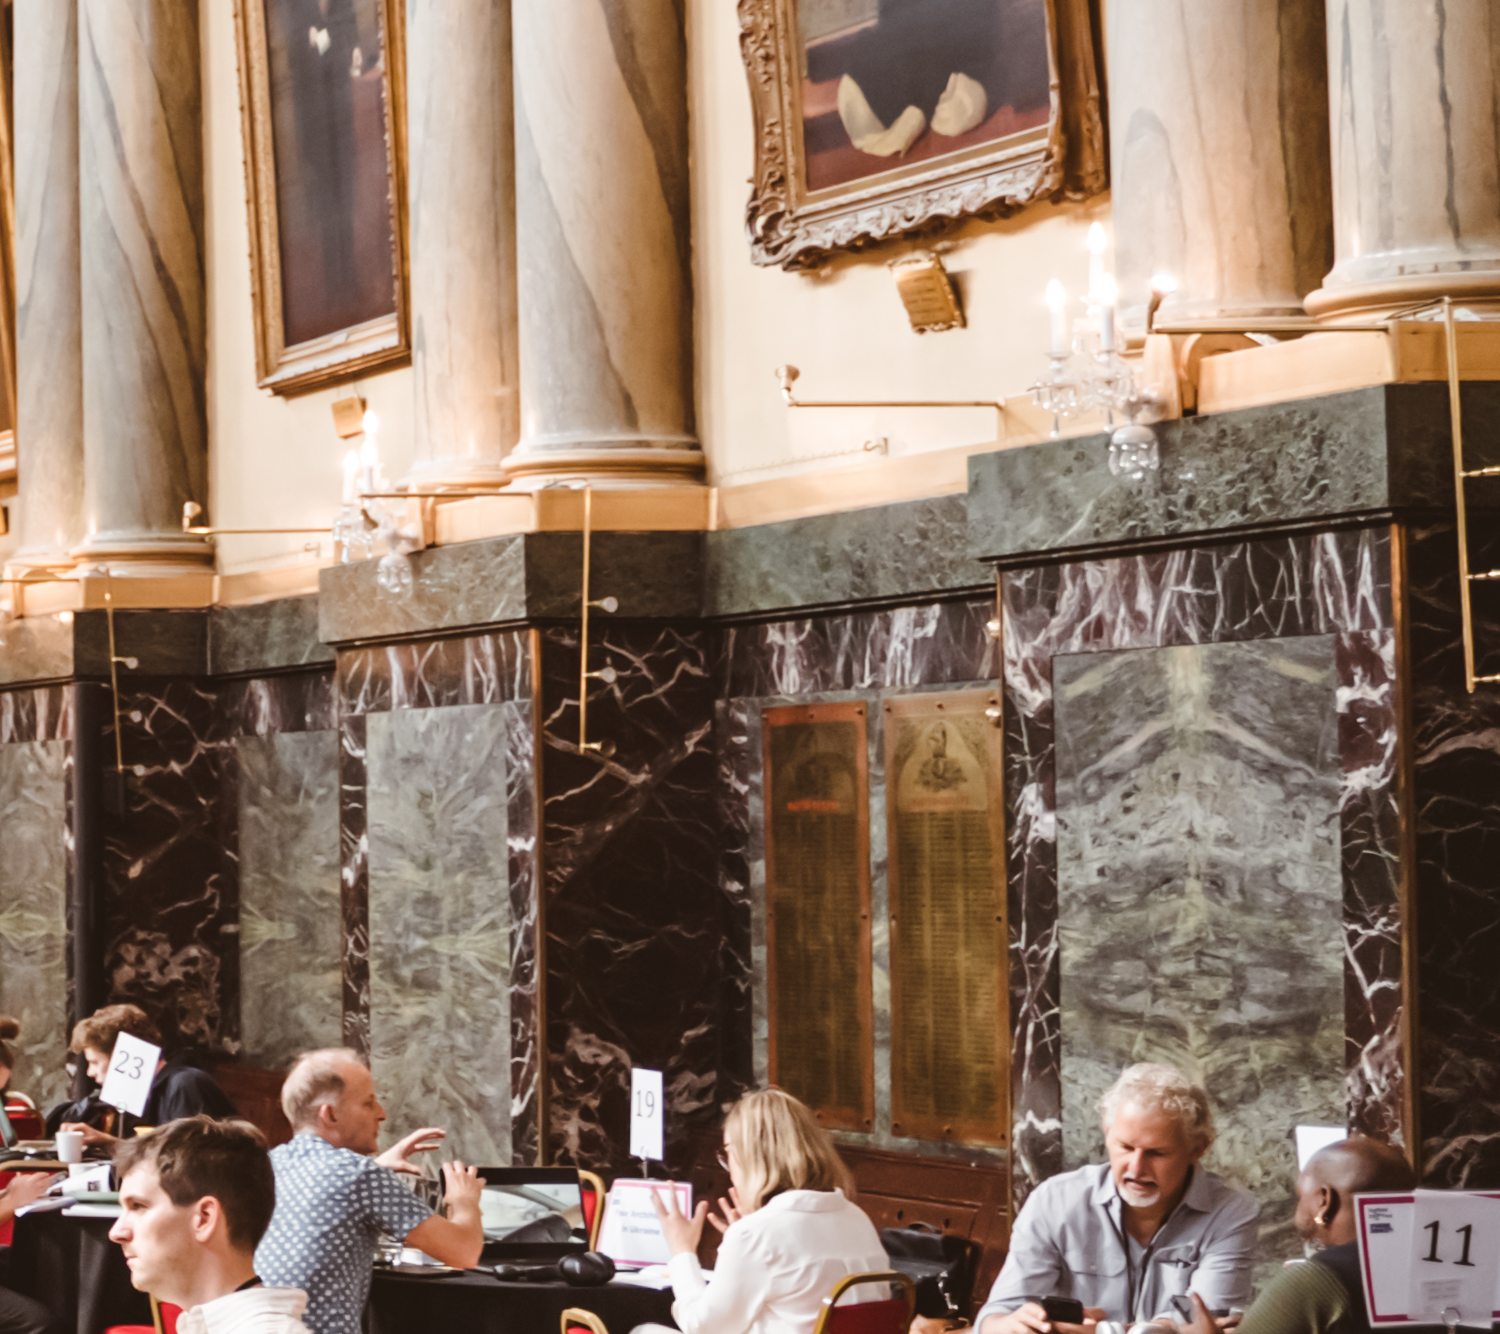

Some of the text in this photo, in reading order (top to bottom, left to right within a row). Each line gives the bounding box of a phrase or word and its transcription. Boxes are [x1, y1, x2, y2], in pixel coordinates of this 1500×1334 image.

[113, 1050, 145, 1080] 23
[636, 1089, 656, 1119] 19
[1421, 1219, 1476, 1268] 11
